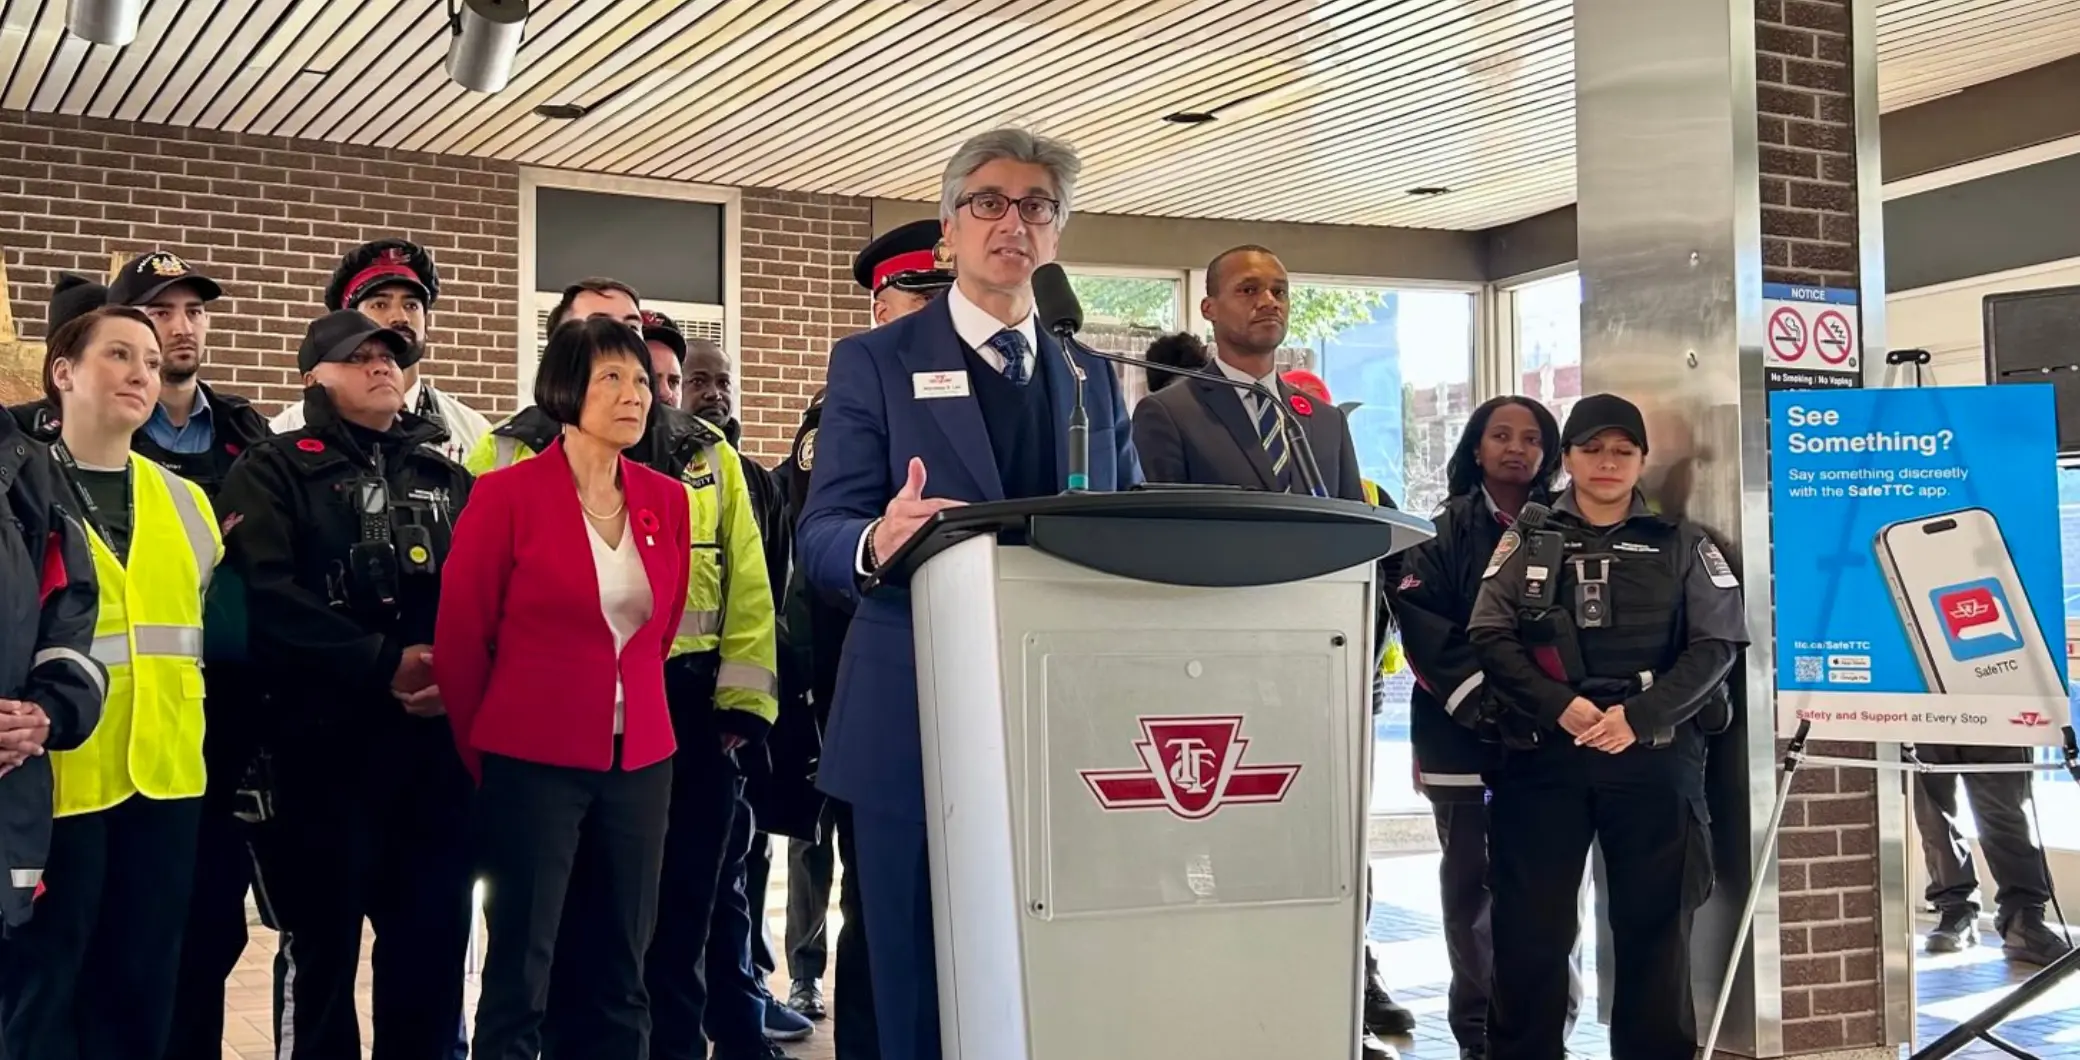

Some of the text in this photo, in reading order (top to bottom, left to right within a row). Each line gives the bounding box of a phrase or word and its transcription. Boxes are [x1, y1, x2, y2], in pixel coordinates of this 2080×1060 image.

[1791, 287, 1826, 300] NOTICE
[1771, 372, 1781, 382] No
[1782, 373, 1813, 386] Smoking
[1818, 375, 1829, 385] No
[1829, 376, 1853, 388] Vaping
[1787, 405, 1840, 427] See
[1788, 429, 1954, 456] Something?
[1788, 466, 1969, 483] Say something discreetly
[1789, 484, 1951, 499] with the SafeTTC app.
[1794, 641, 1871, 650] ttc.ca/SafeTTC
[1974, 659, 2019, 679] SafeTTC
[1795, 709, 1988, 725] Safety and Support at Every Stop
